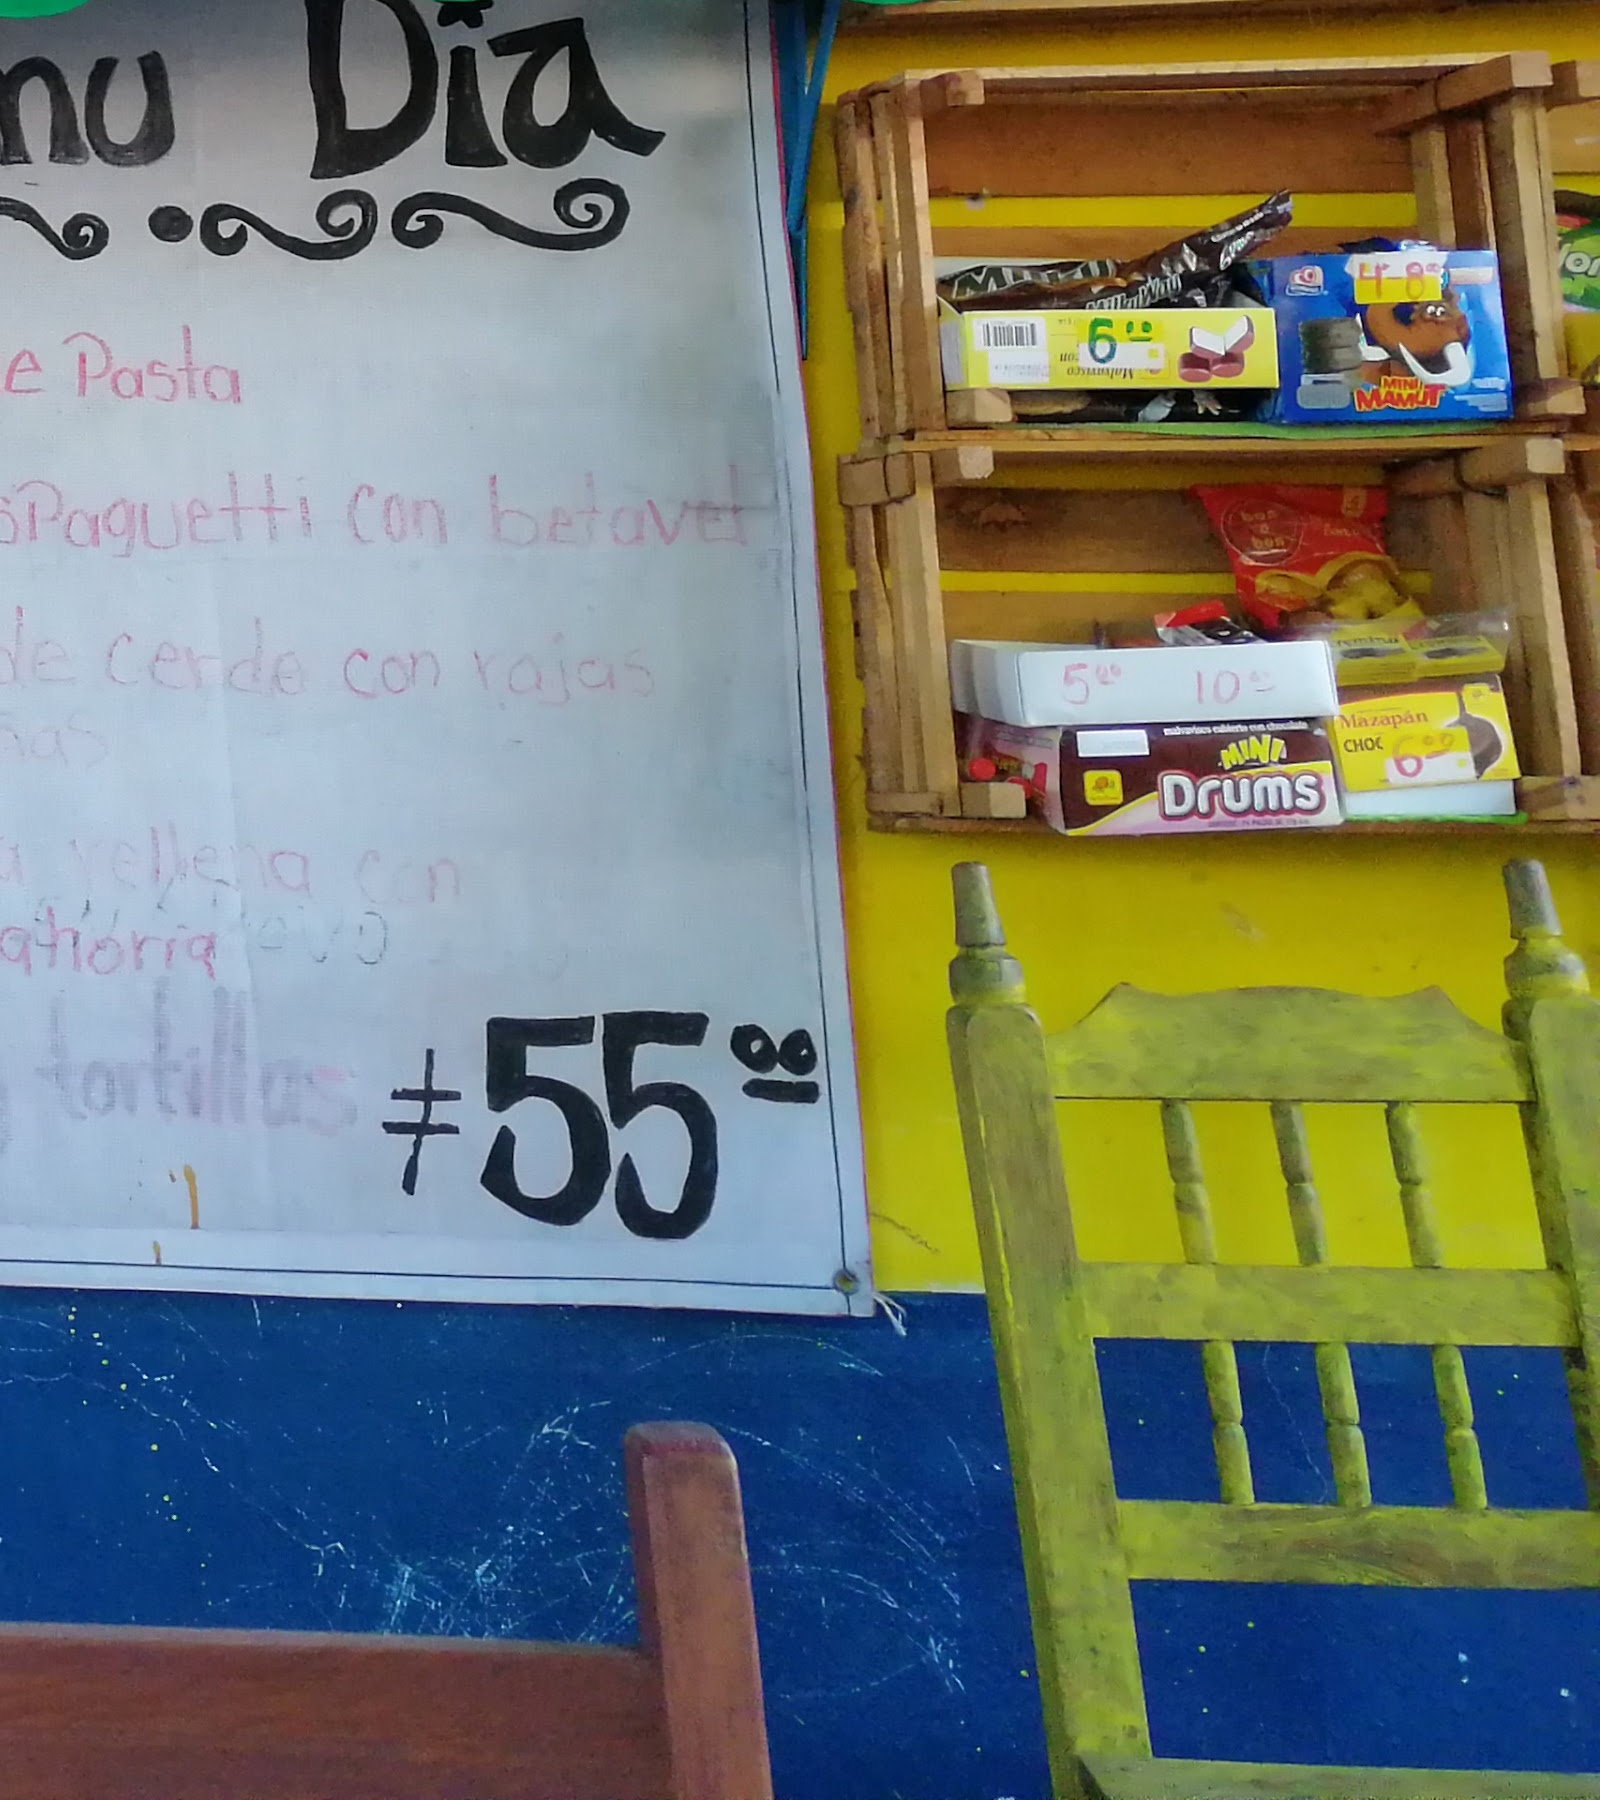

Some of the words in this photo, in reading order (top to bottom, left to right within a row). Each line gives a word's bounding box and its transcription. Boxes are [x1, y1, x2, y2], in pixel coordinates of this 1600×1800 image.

[62, 324, 243, 404] Pasta
[1382, 375, 1420, 392] MINI
[1355, 384, 1447, 412] MAMUT
[342, 647, 441, 698] con
[1339, 708, 1428, 729] Mazapán
[1220, 733, 1285, 770] MINI
[1159, 772, 1324, 819] Drums
[34, 974, 359, 1137] tortillas
